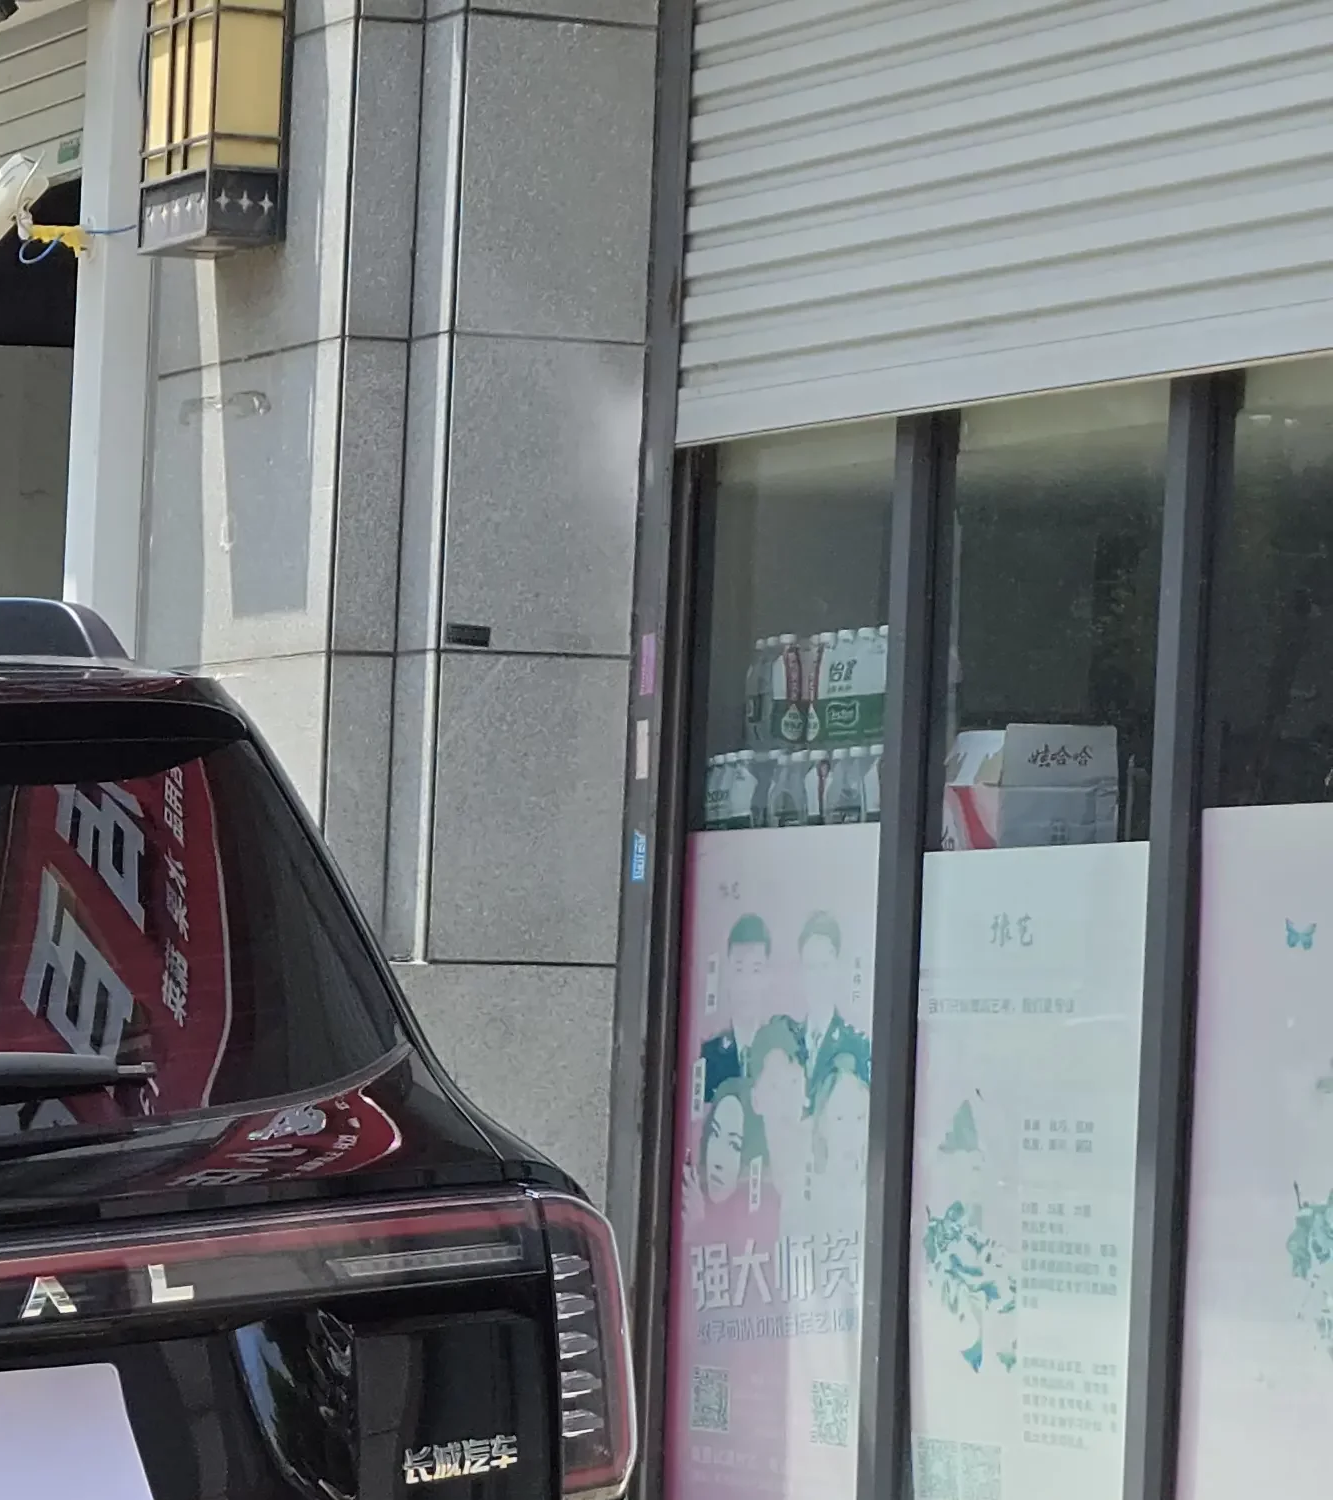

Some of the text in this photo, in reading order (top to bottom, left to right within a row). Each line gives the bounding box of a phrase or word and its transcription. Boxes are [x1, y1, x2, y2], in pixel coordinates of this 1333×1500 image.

[1028, 743, 1093, 768] 娃哈哈
[690, 1229, 859, 1312] 强大师资
[403, 1435, 518, 1484] 长城汽车
